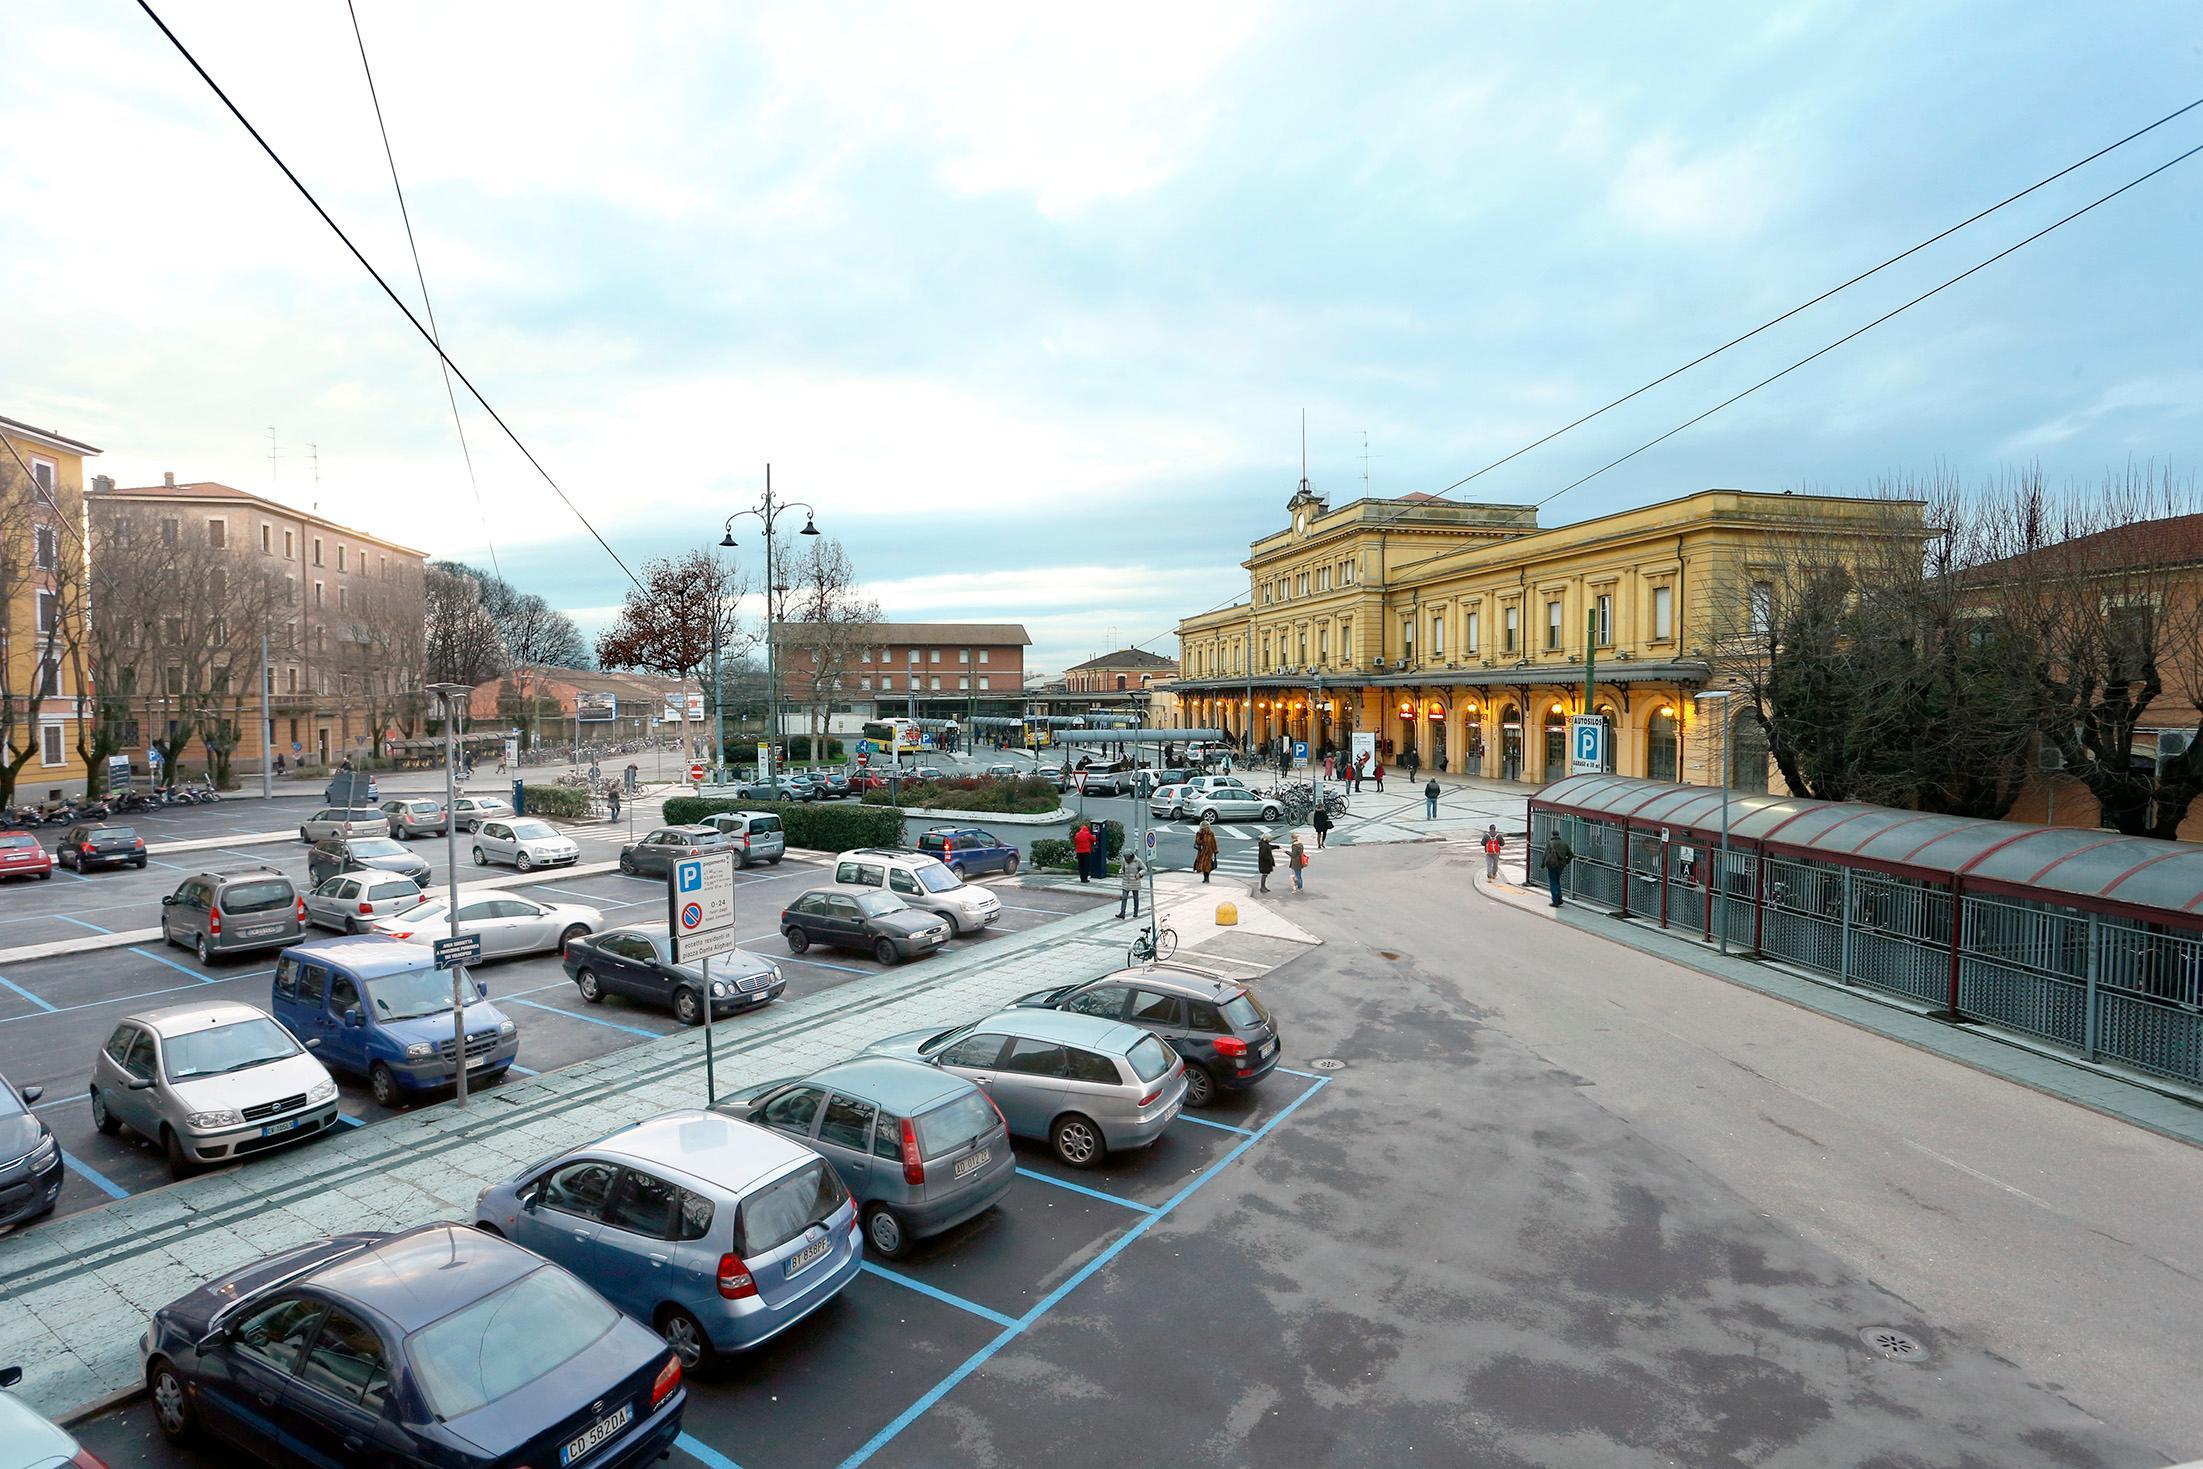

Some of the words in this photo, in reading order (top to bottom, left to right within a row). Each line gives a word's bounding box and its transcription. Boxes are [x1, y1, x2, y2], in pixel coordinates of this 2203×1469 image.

[1573, 717, 1602, 726] AUTOSILOS
[1295, 743, 1305, 757] P
[1583, 734, 1595, 759] P
[149, 751, 156, 761] P
[1683, 864, 1690, 875] A
[683, 866, 697, 889] P
[704, 935, 725, 945] residenti
[682, 949, 698, 960] piazza
[699, 945, 713, 956] Dante
[714, 940, 733, 951] Alighieri
[792, 1255, 801, 1268] BT
[569, 1437, 586, 1458] CD
[589, 1410, 626, 1445] 582DA
